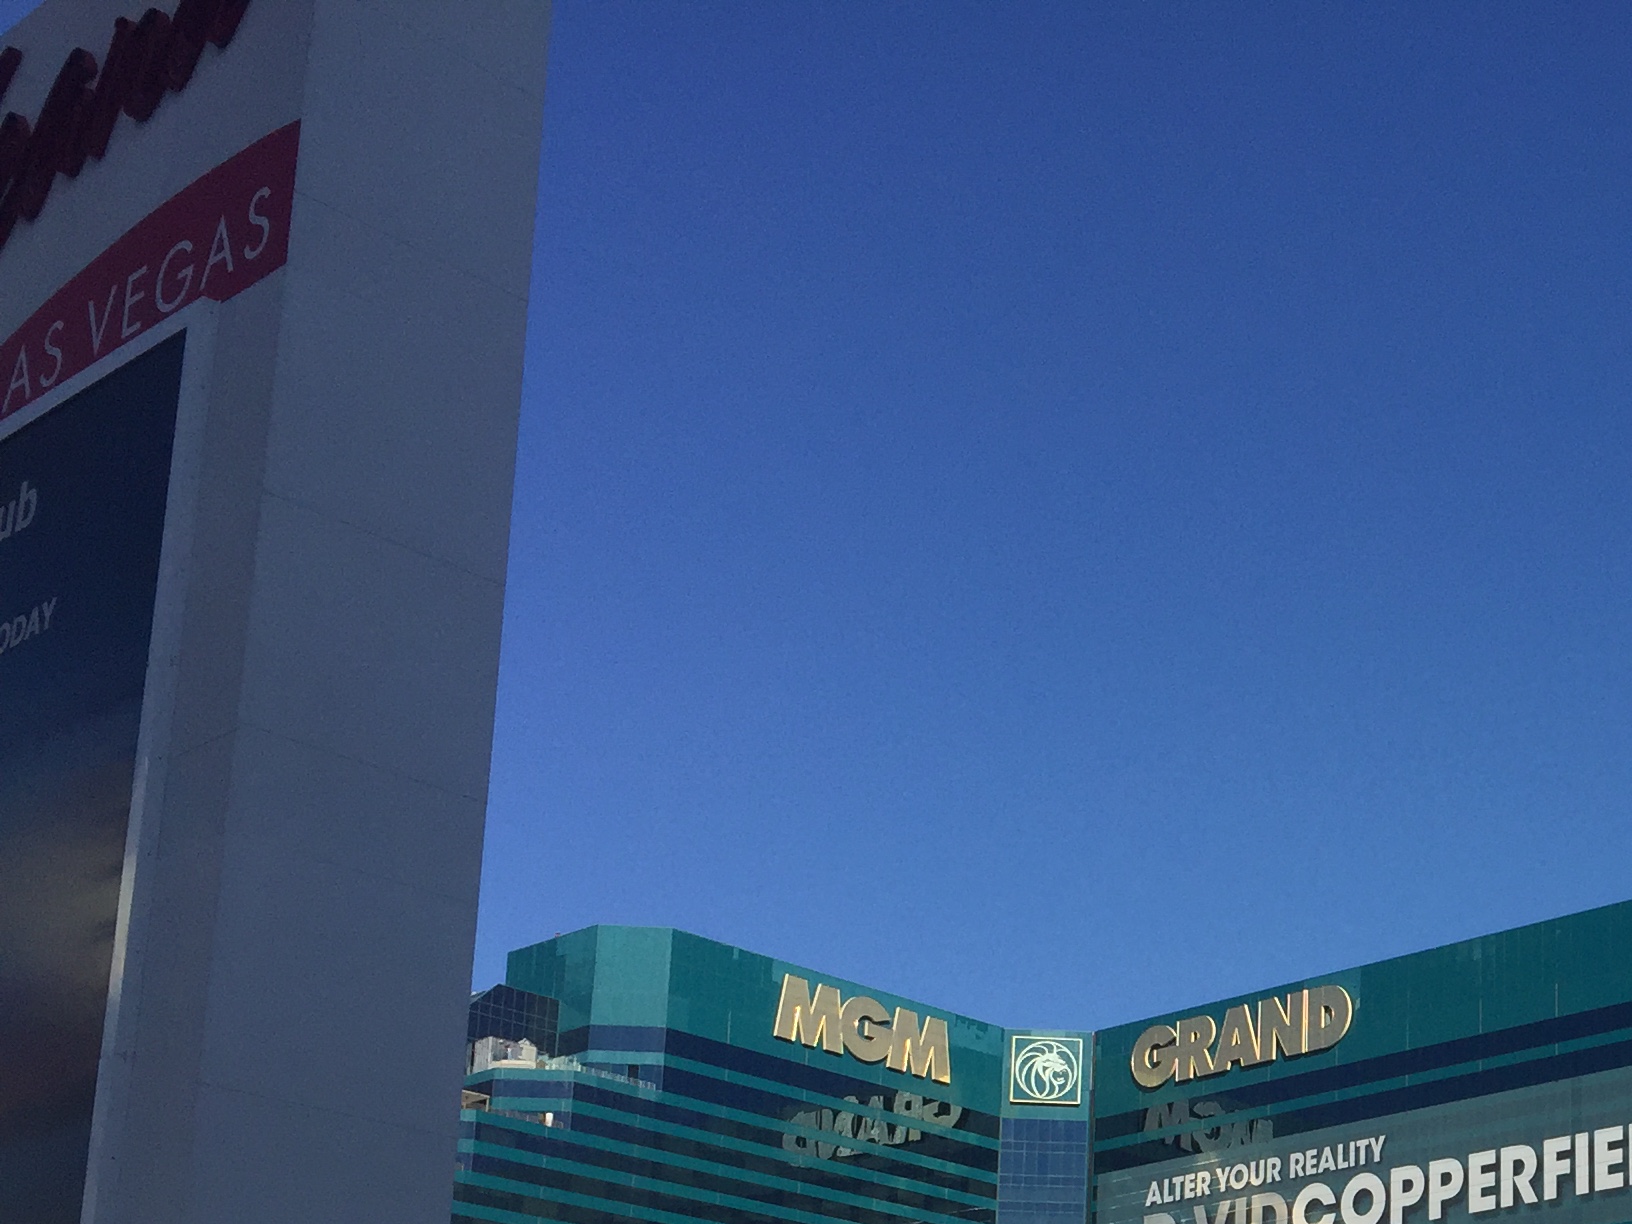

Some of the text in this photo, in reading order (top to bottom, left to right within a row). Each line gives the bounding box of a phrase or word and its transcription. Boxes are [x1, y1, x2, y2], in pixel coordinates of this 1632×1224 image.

[87, 186, 271, 357] VEGAS
[773, 973, 950, 1084] MGM
[1131, 985, 1352, 1088] GRAND
[1145, 1135, 1386, 1207] ALTER YOUR REALITY
